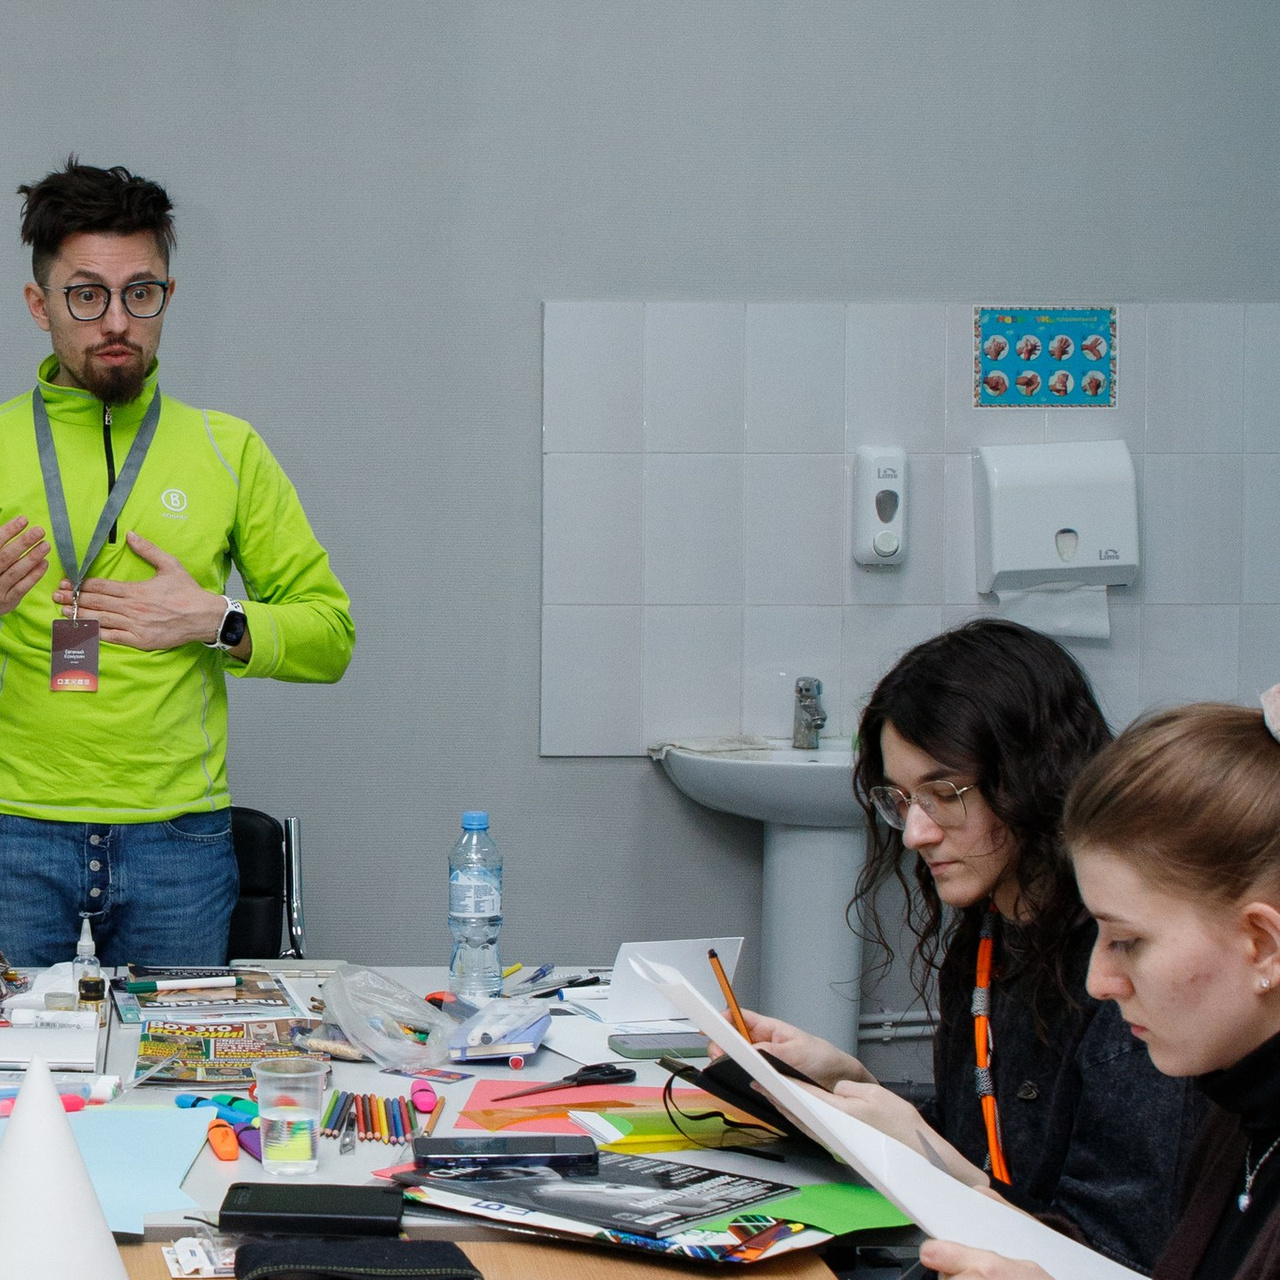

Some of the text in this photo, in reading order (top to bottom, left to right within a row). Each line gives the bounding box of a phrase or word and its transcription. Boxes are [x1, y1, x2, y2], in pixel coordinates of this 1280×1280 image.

[149, 1027, 244, 1038] ИСТОРИИ!
[150, 1021, 232, 1033] ВОТ ЭТО
